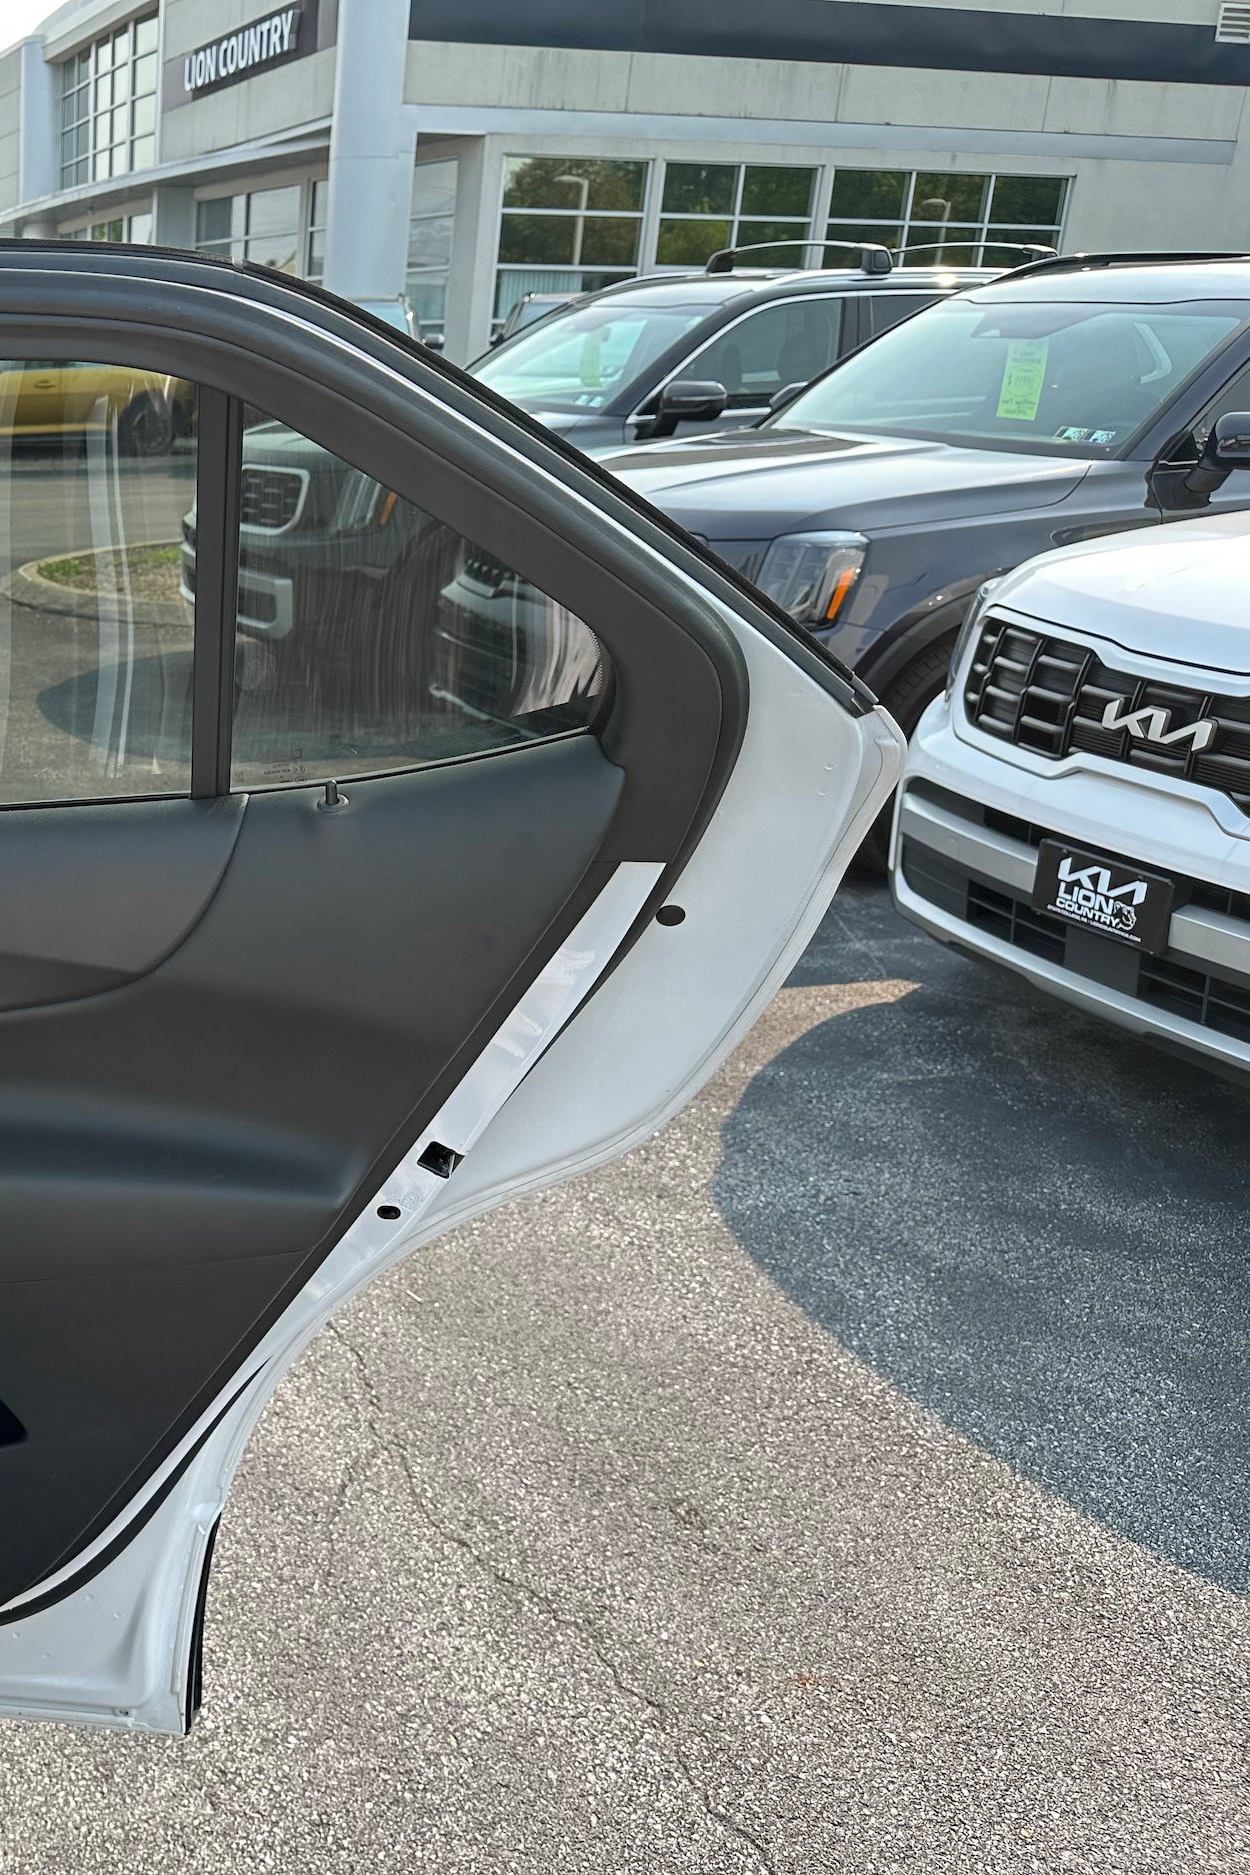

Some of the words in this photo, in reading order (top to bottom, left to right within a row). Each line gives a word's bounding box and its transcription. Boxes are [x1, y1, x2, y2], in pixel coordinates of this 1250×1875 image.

[184, 45, 217, 91] LION
[218, 9, 294, 77] COUNTRY
[1102, 697, 1216, 752] KIA
[1058, 857, 1148, 905] KIA
[1058, 881, 1114, 915] LION
[1056, 897, 1120, 927] COUNTRY
